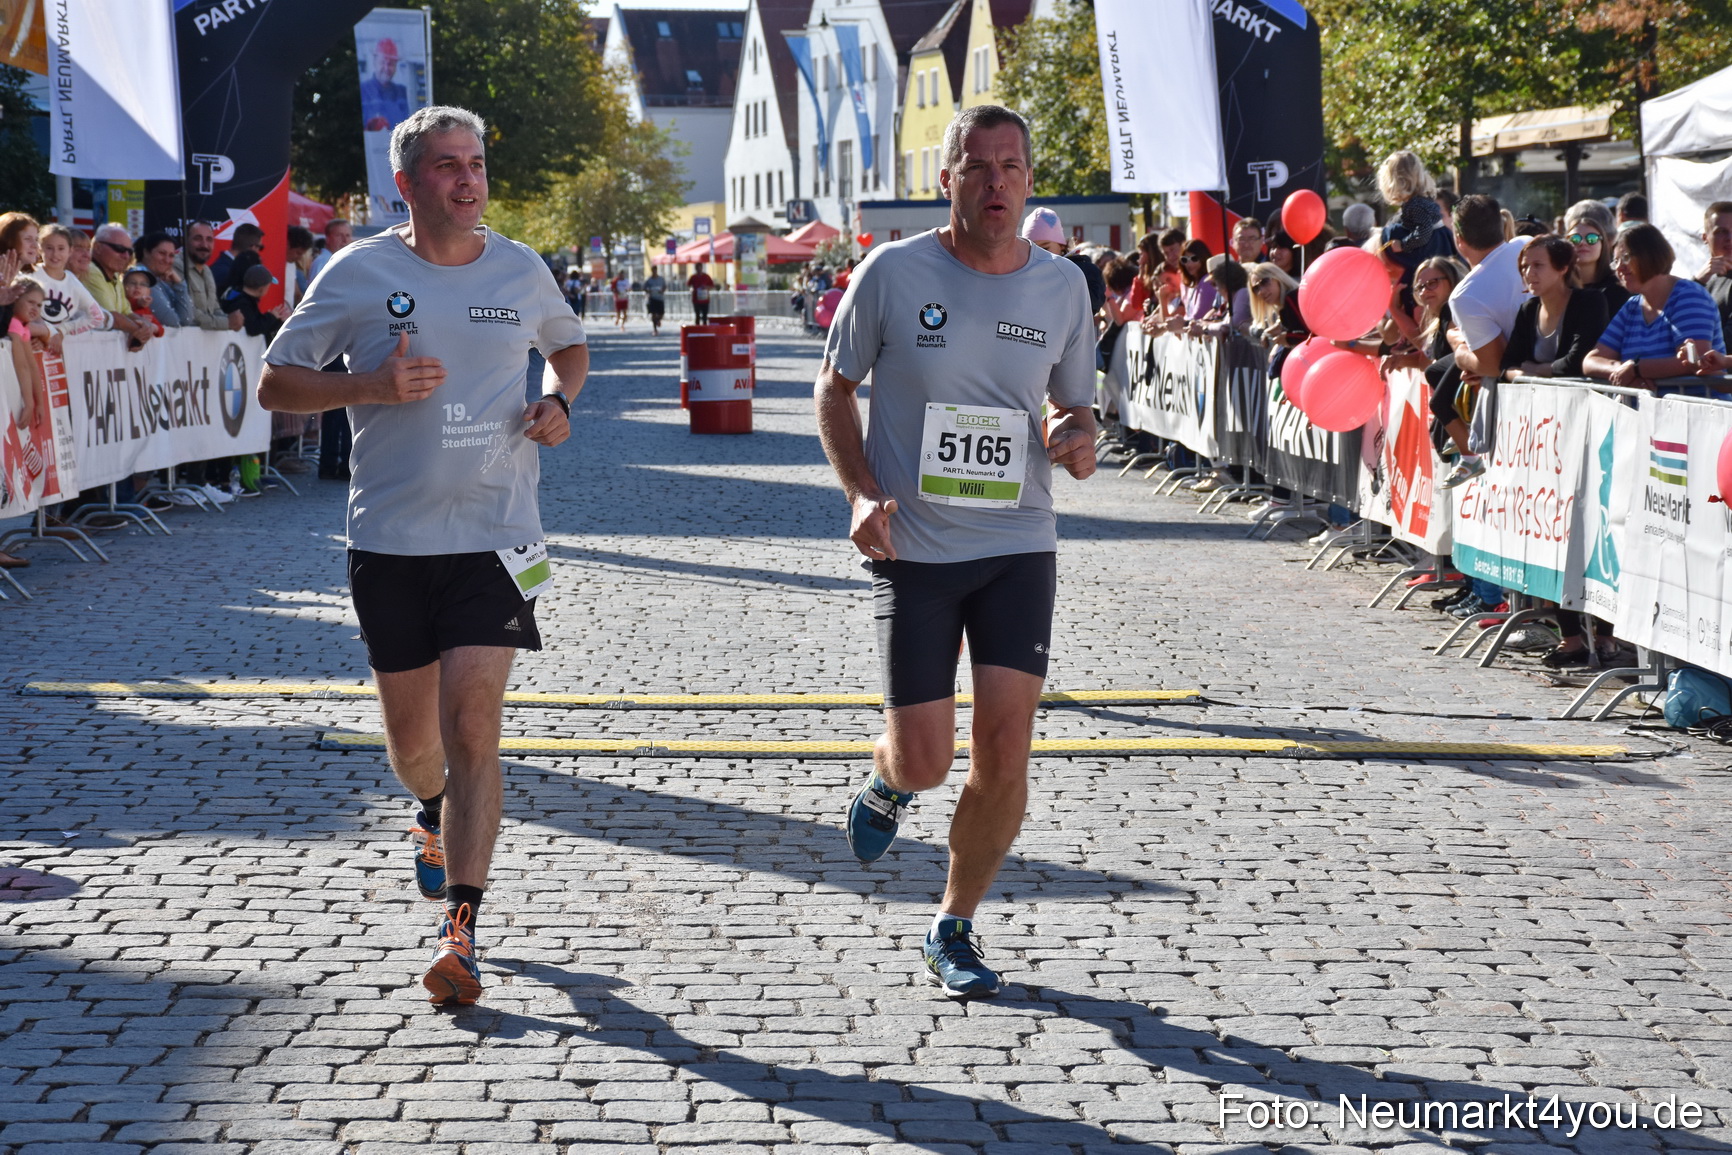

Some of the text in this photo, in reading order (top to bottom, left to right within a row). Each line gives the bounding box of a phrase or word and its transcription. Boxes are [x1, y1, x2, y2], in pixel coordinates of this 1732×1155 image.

[193, 0, 268, 36] PAR
[1212, 0, 1282, 43] ARKT
[468, 307, 520, 320] BOCK
[389, 321, 418, 331] PARTL
[998, 321, 1046, 344] BOCK
[390, 329, 418, 337] Neuarkt
[917, 335, 946, 343] PARTL
[442, 403, 472, 422] 19.
[957, 414, 1000, 427] BOCK
[442, 421, 502, 434] Neumarkter
[442, 434, 493, 449] Stadtlauf
[938, 432, 1011, 466] 5165
[943, 467, 996, 477] PARTL Neumarkt
[959, 482, 985, 496] Willi
[525, 553, 541, 564] PARTL
[504, 624, 521, 632] adidas
